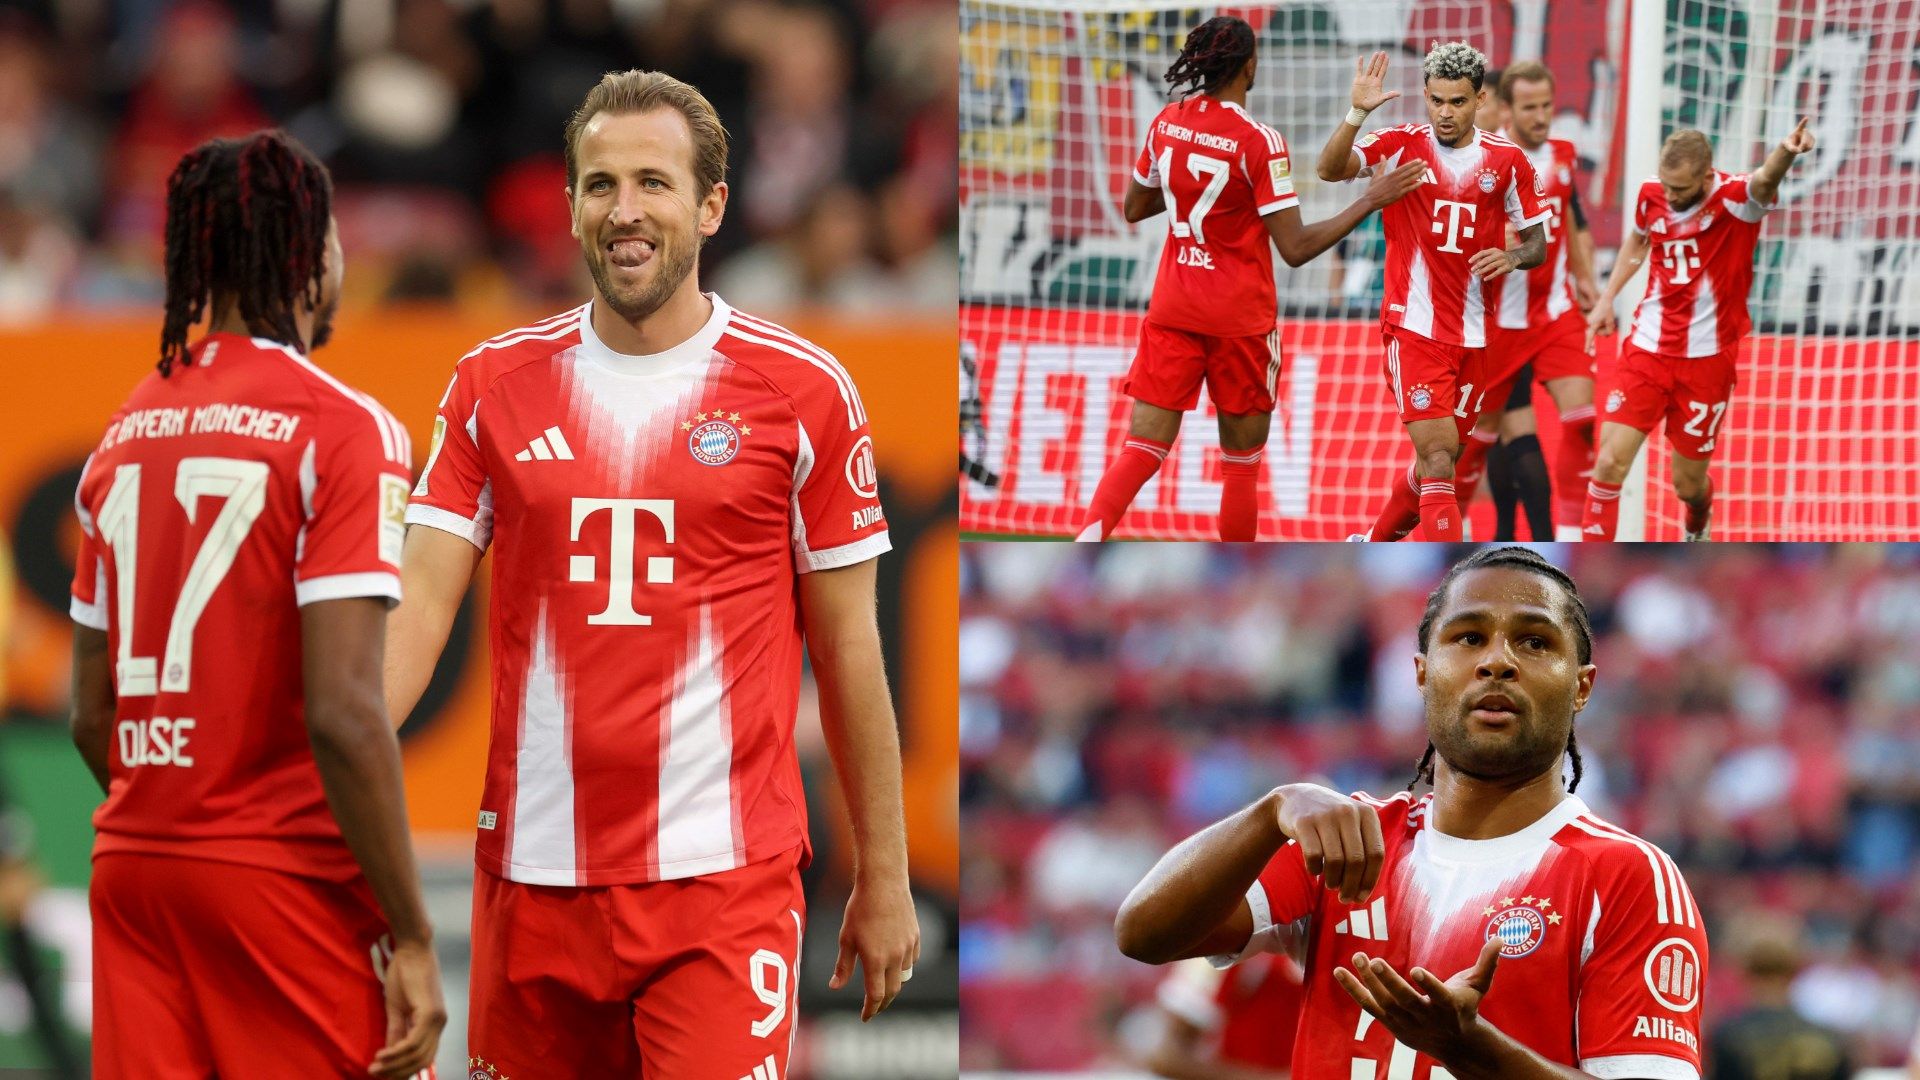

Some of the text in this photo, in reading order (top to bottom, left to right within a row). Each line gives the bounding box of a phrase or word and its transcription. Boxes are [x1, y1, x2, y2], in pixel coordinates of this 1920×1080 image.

[1158, 146, 1230, 244] 17
[1432, 199, 1477, 254] T
[1663, 238, 1700, 284] T
[694, 424, 736, 441] FC BAYERN
[1684, 400, 1726, 437] 27
[97, 457, 269, 697] 17
[569, 497, 675, 626] T
[1493, 910, 1540, 930] FC BAYERN
[750, 949, 787, 1038] 9
